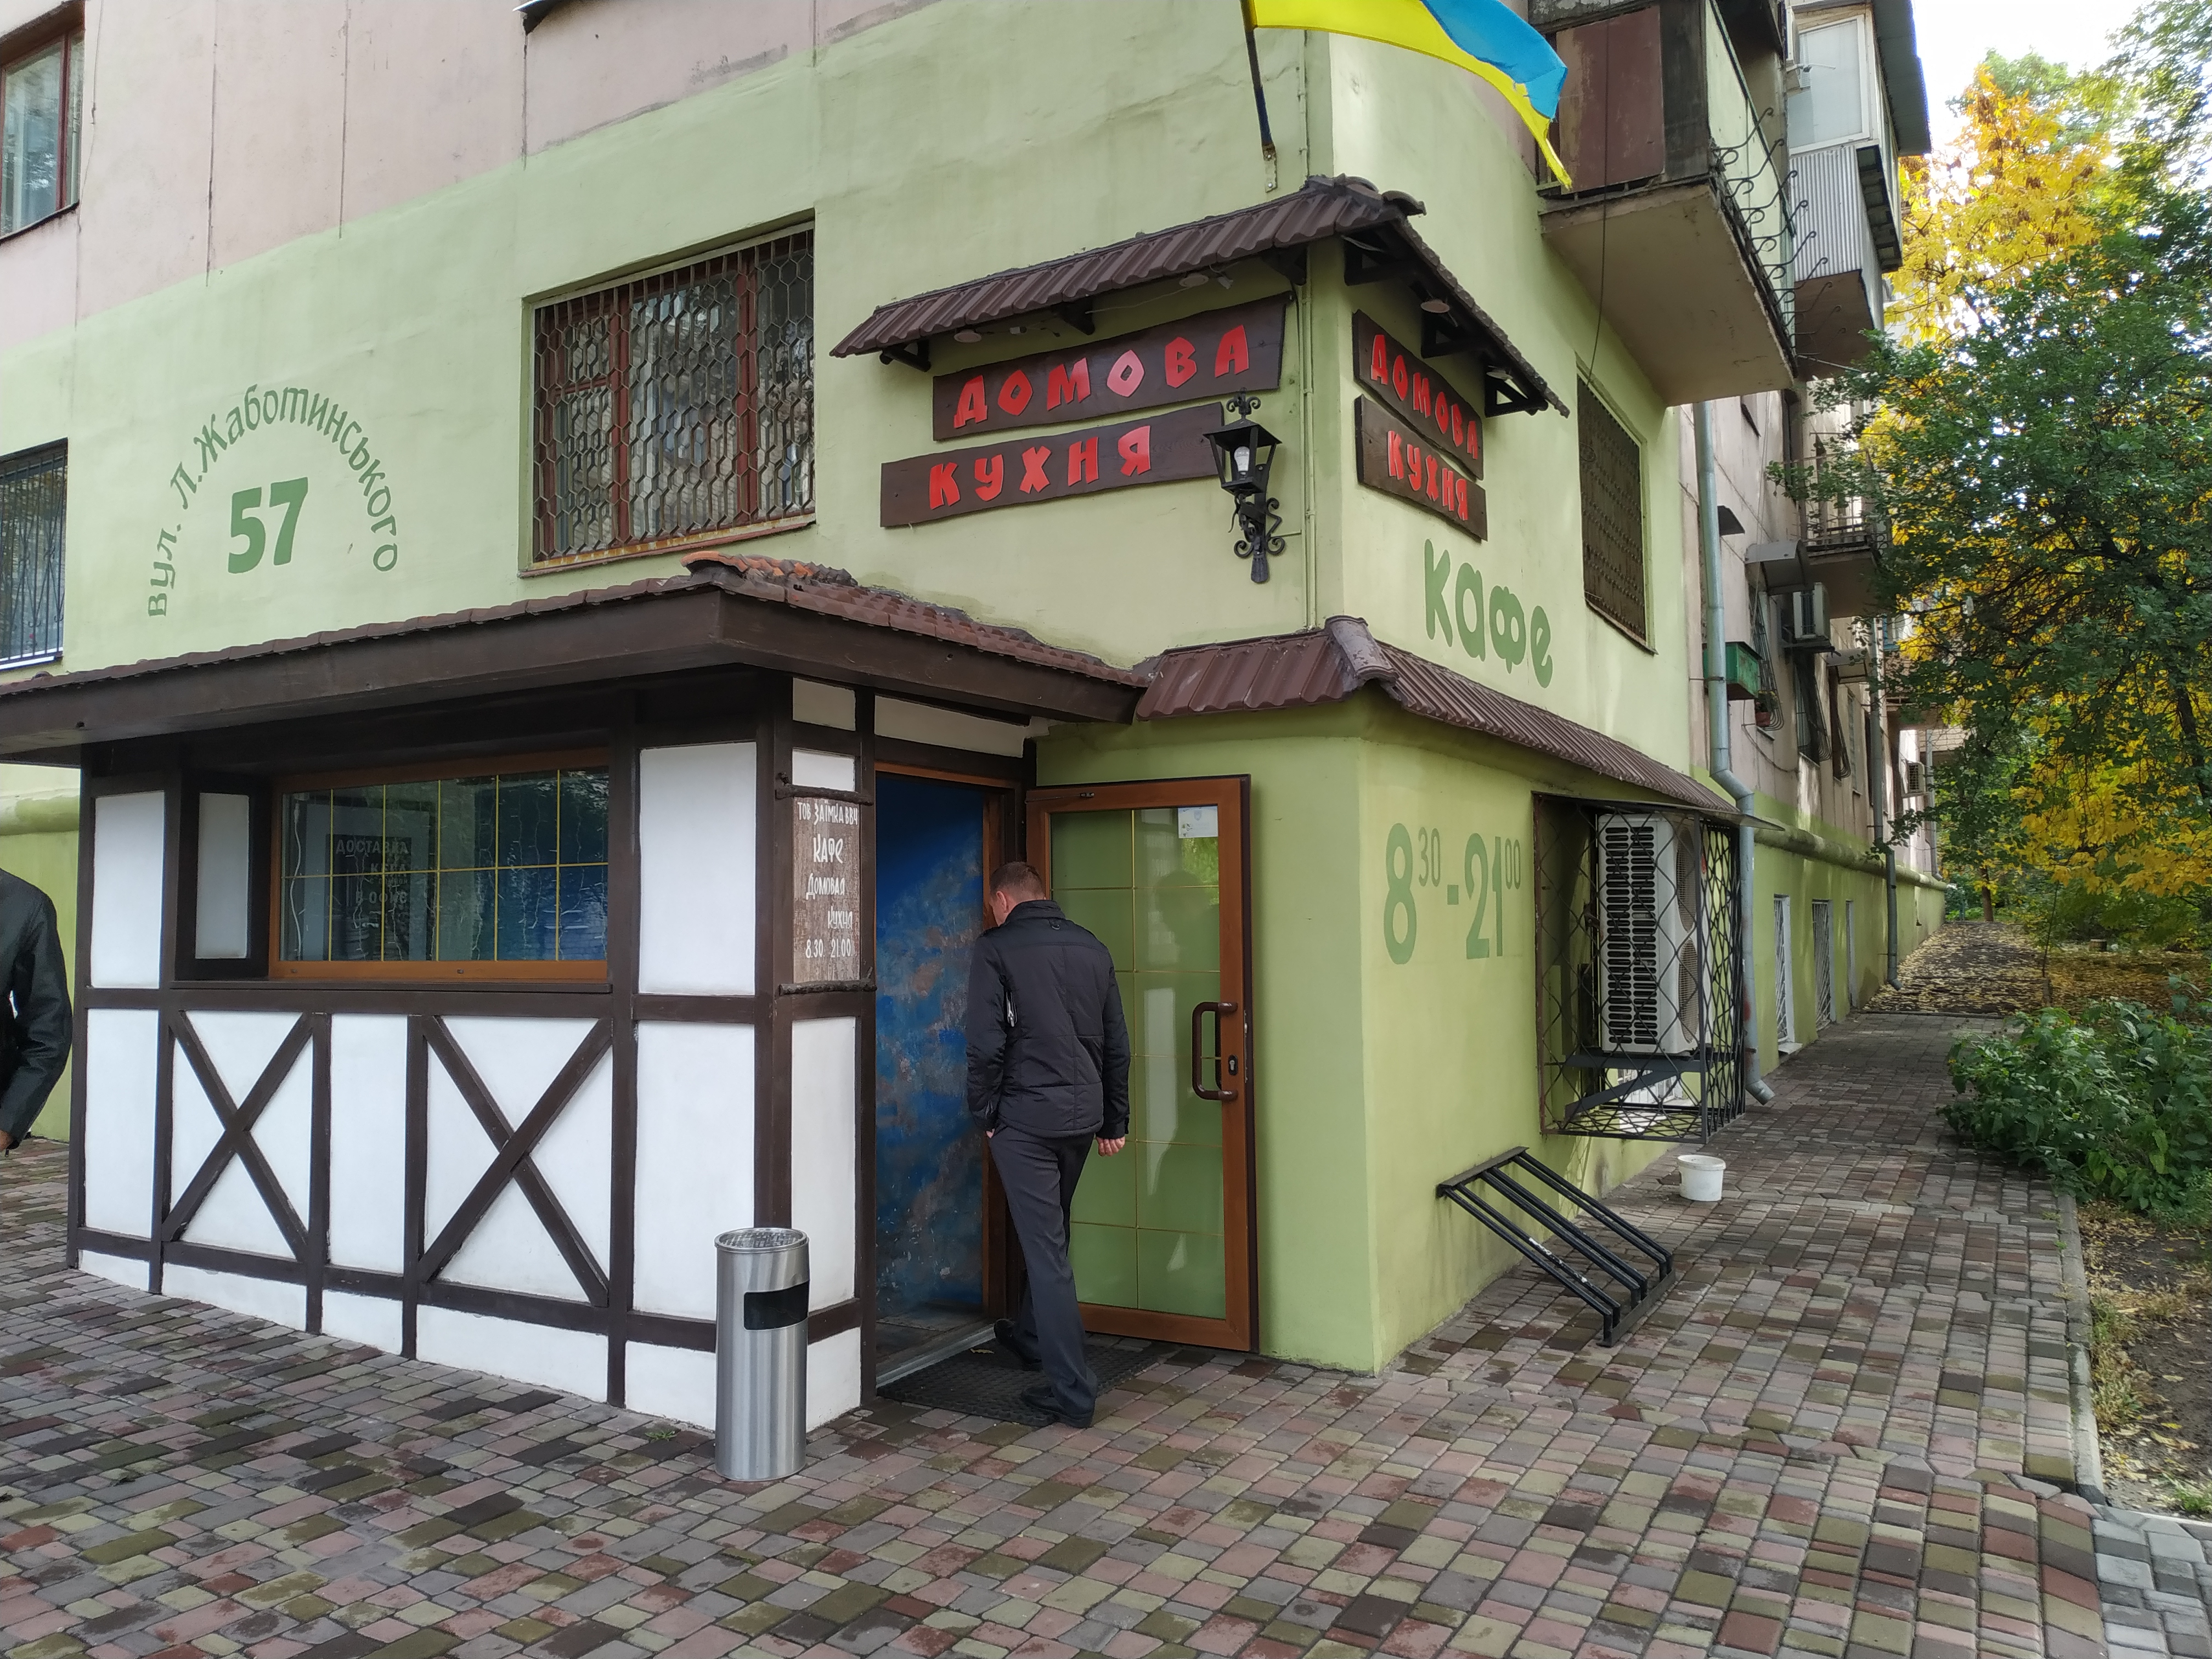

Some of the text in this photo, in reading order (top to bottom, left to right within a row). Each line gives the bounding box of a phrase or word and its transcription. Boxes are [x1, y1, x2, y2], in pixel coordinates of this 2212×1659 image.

[953, 325, 1249, 428] ДОМОВА
[1370, 334, 1479, 460] ДОМОВА
[929, 425, 1152, 510] КУХНЯ
[1387, 430, 1468, 521] КУХНЯ
[148, 523, 182, 617] вул.
[228, 477, 308, 574] 57
[797, 802, 811, 821] ТОВ
[827, 905, 853, 929] КУХНЯ
